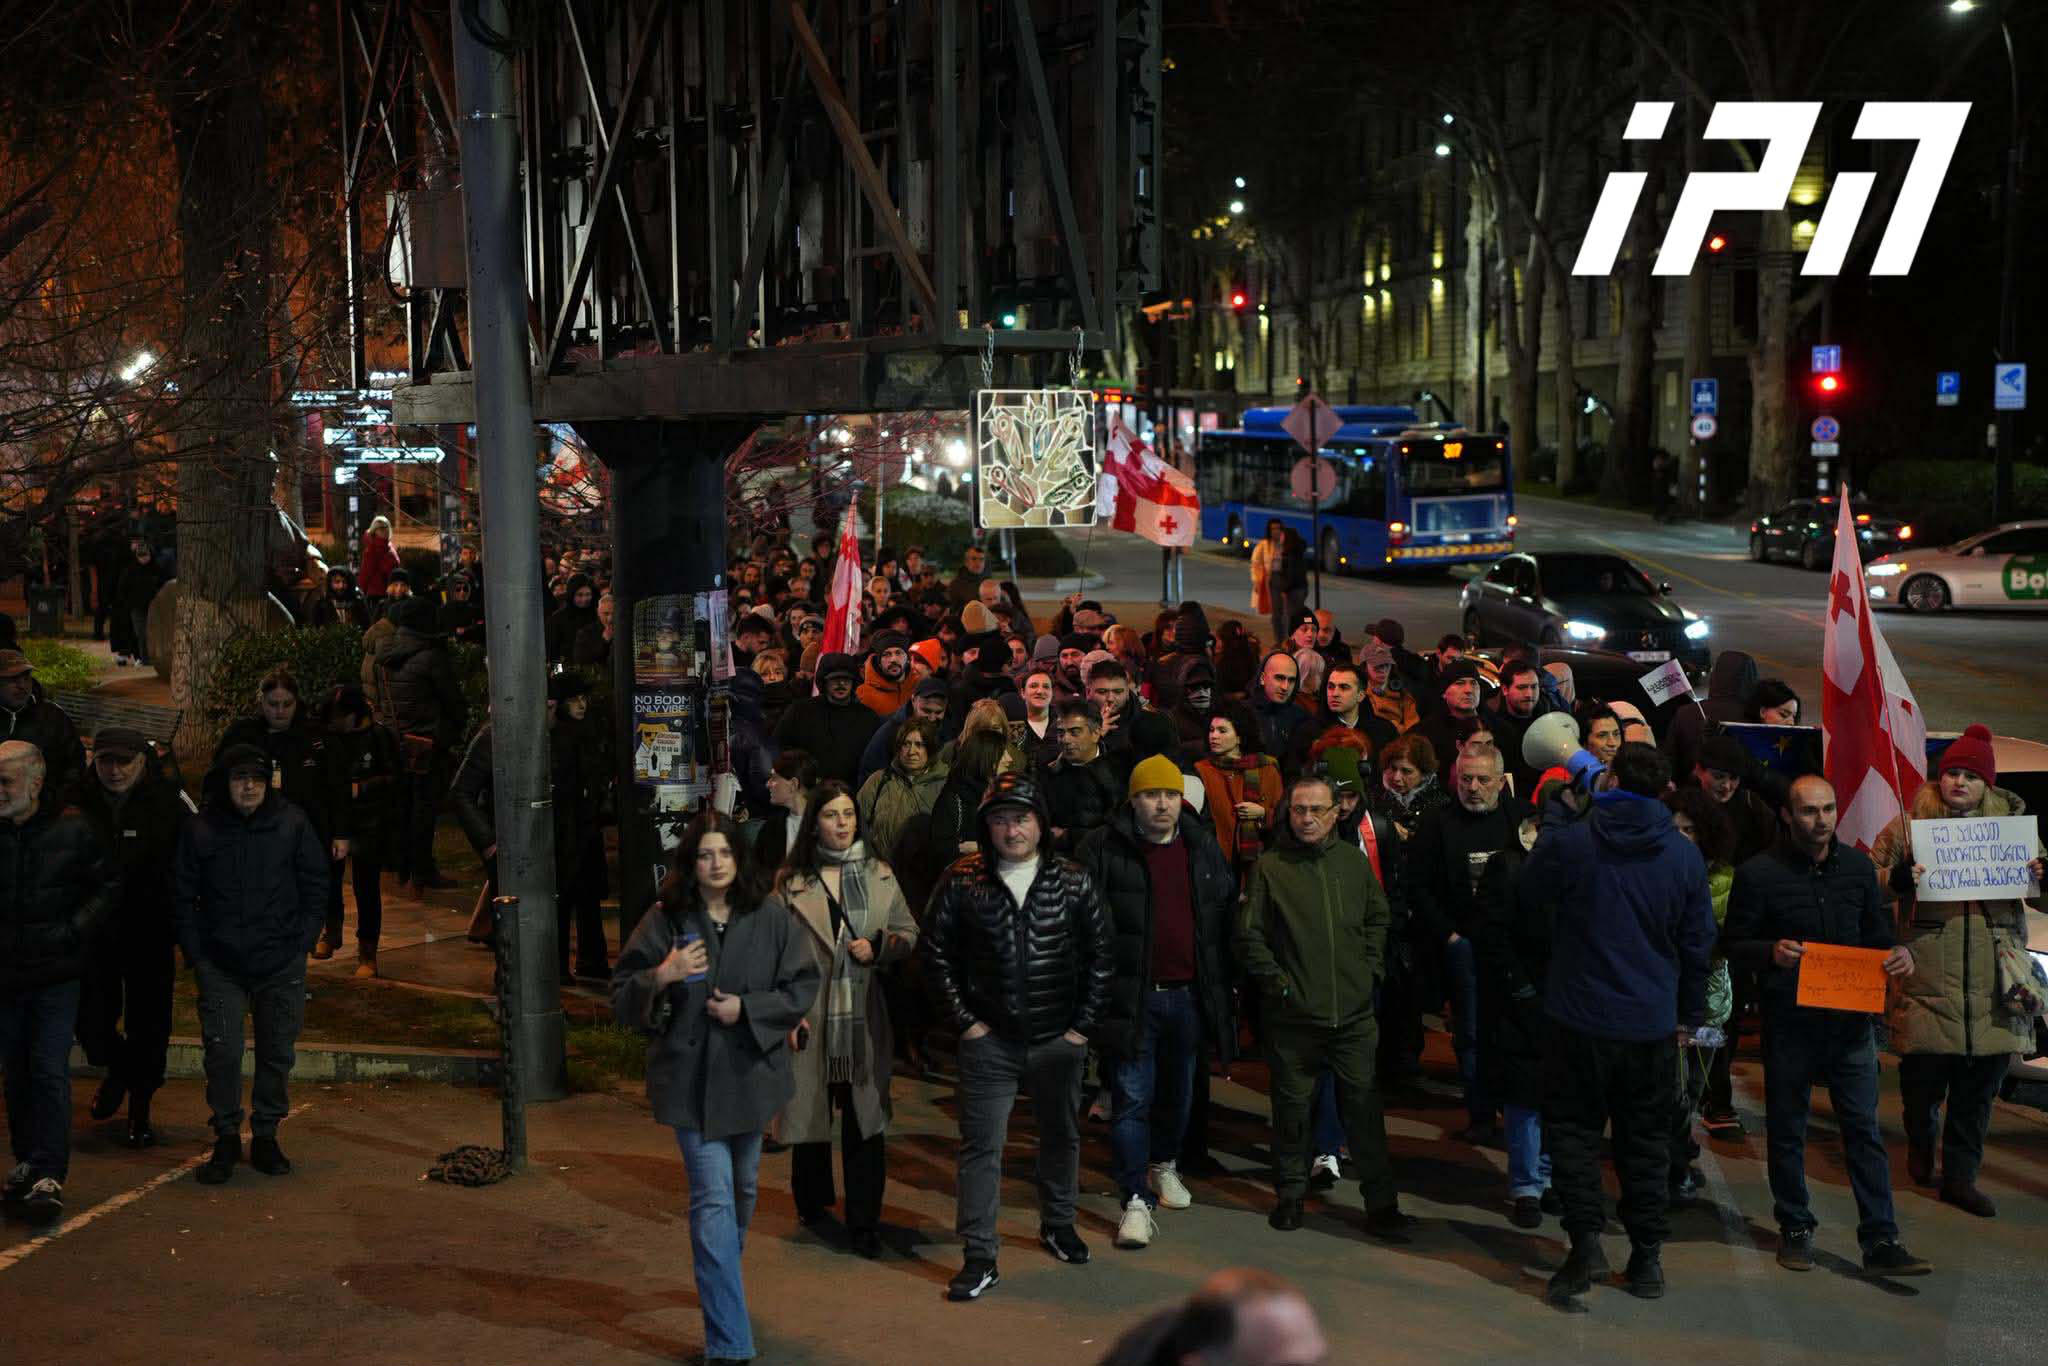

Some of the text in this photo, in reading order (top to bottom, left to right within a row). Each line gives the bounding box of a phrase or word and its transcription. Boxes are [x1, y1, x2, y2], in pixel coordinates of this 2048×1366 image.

[1942, 375, 1955, 393] P
[1697, 423, 1712, 431] 40
[634, 695, 691, 705] NO BOOM
[634, 704, 660, 713] ONLY
